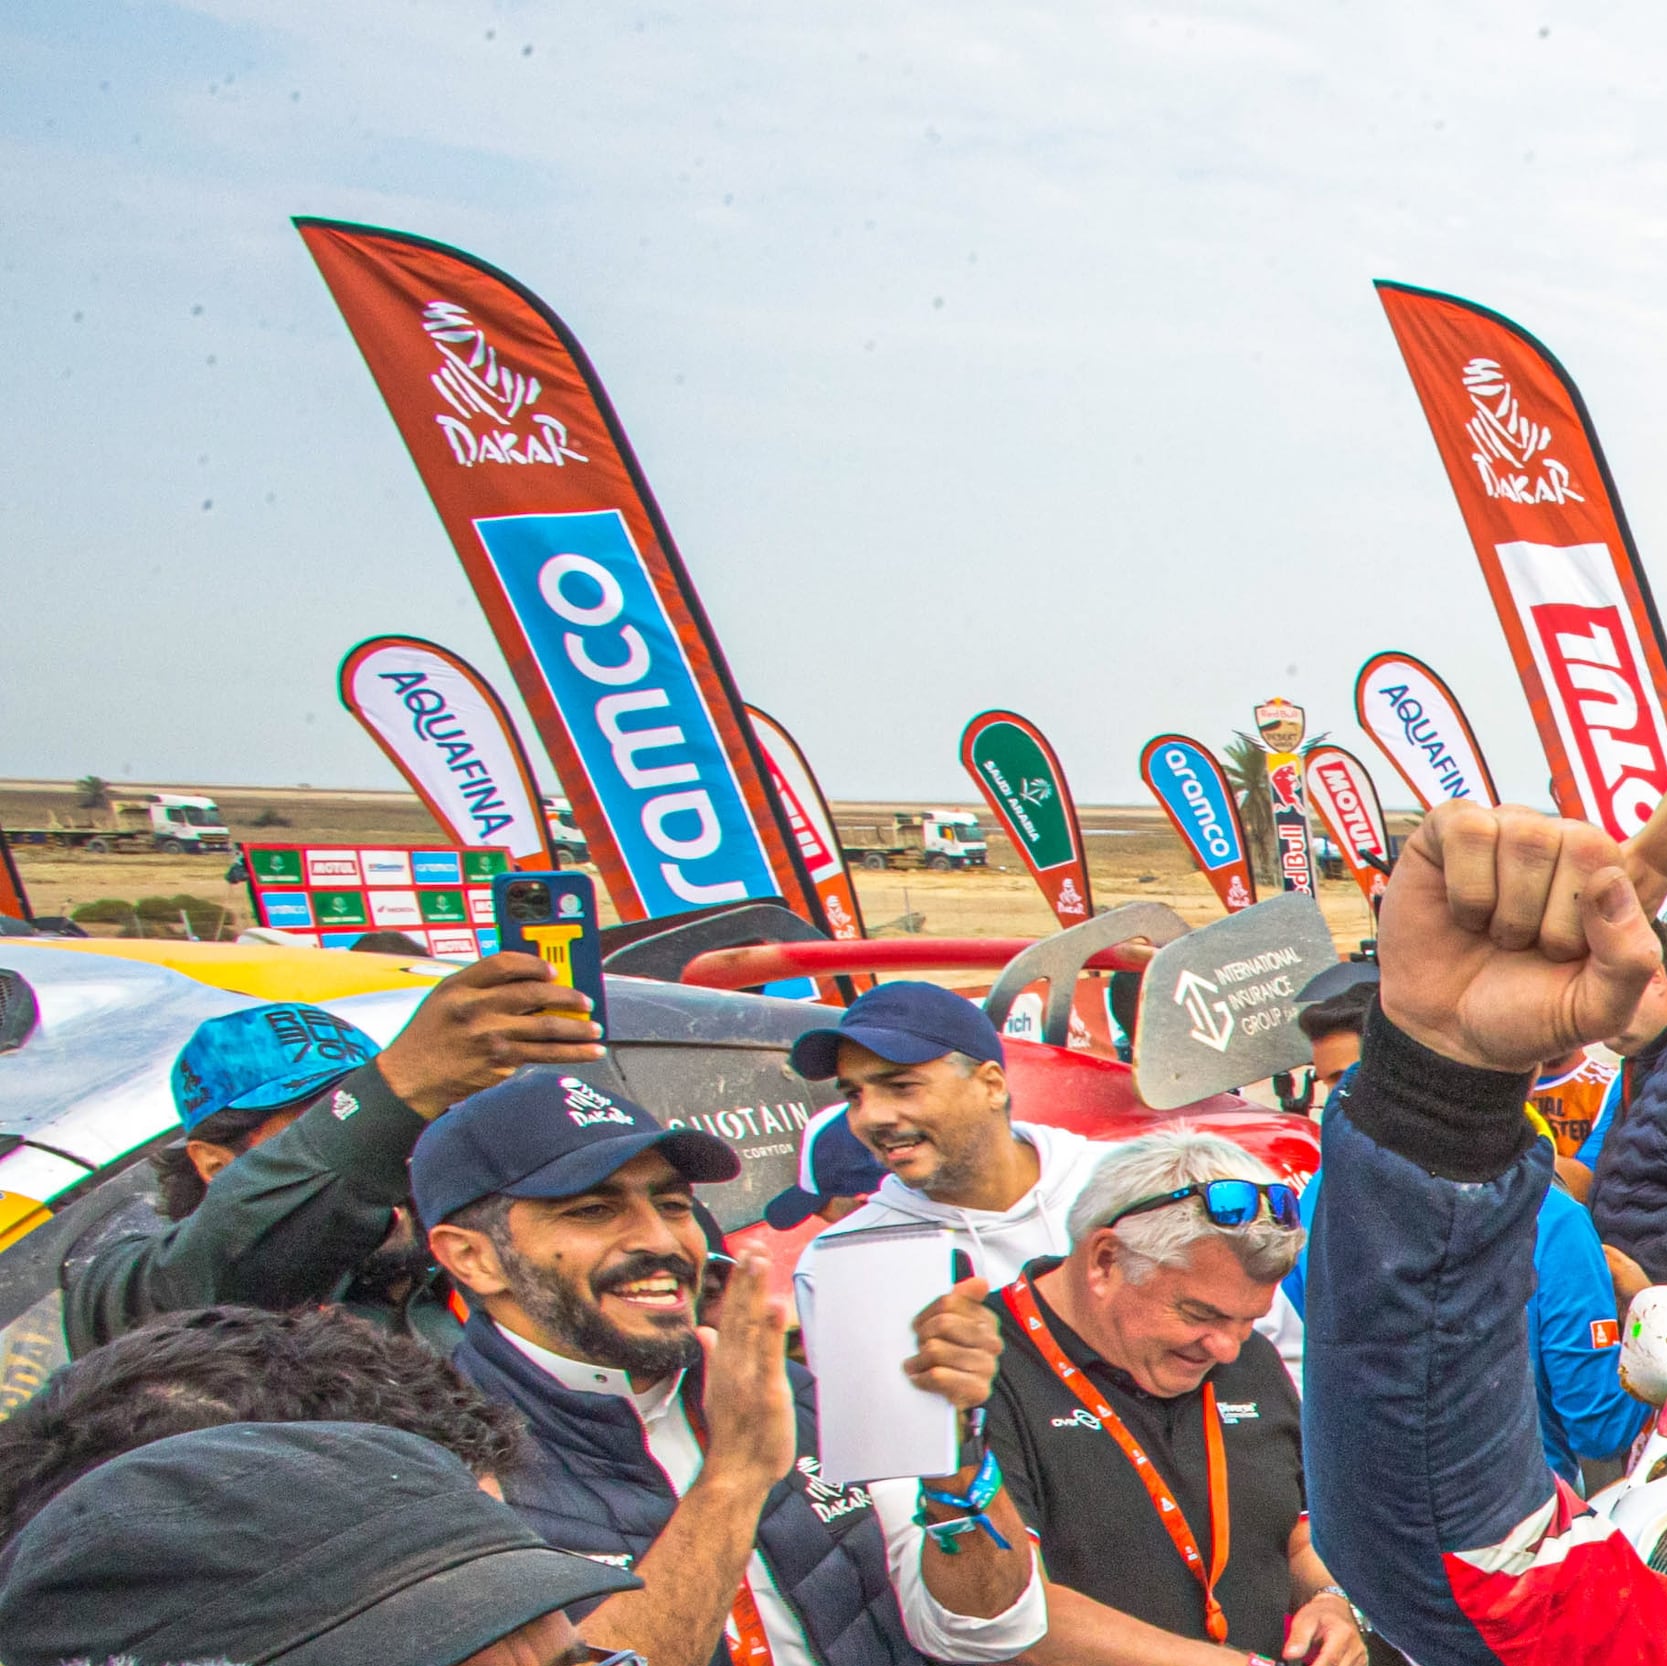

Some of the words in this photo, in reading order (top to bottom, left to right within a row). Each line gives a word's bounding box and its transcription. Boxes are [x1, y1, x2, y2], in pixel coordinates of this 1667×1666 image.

[436, 414, 589, 467] DAKAR
[1472, 450, 1585, 504] DAKAR
[537, 553, 748, 902] ramco
[1380, 685, 1469, 798] AQUAFIN
[378, 670, 515, 842] AQUAFINA
[982, 760, 1012, 799] SAUDI
[1007, 795, 1040, 843] ARABIA
[1164, 749, 1231, 857] aramco
[1325, 771, 1379, 850] MOTUL
[313, 861, 356, 875] MOTUL
[1213, 946, 1303, 987] INTERNATIONAL
[1227, 975, 1295, 1012] INSURANCE
[1240, 1007, 1284, 1036] GROUP
[568, 1108, 636, 1128] DAKAR
[743, 1142, 794, 1160] CORYTON
[811, 1492, 873, 1524] DAKAR
